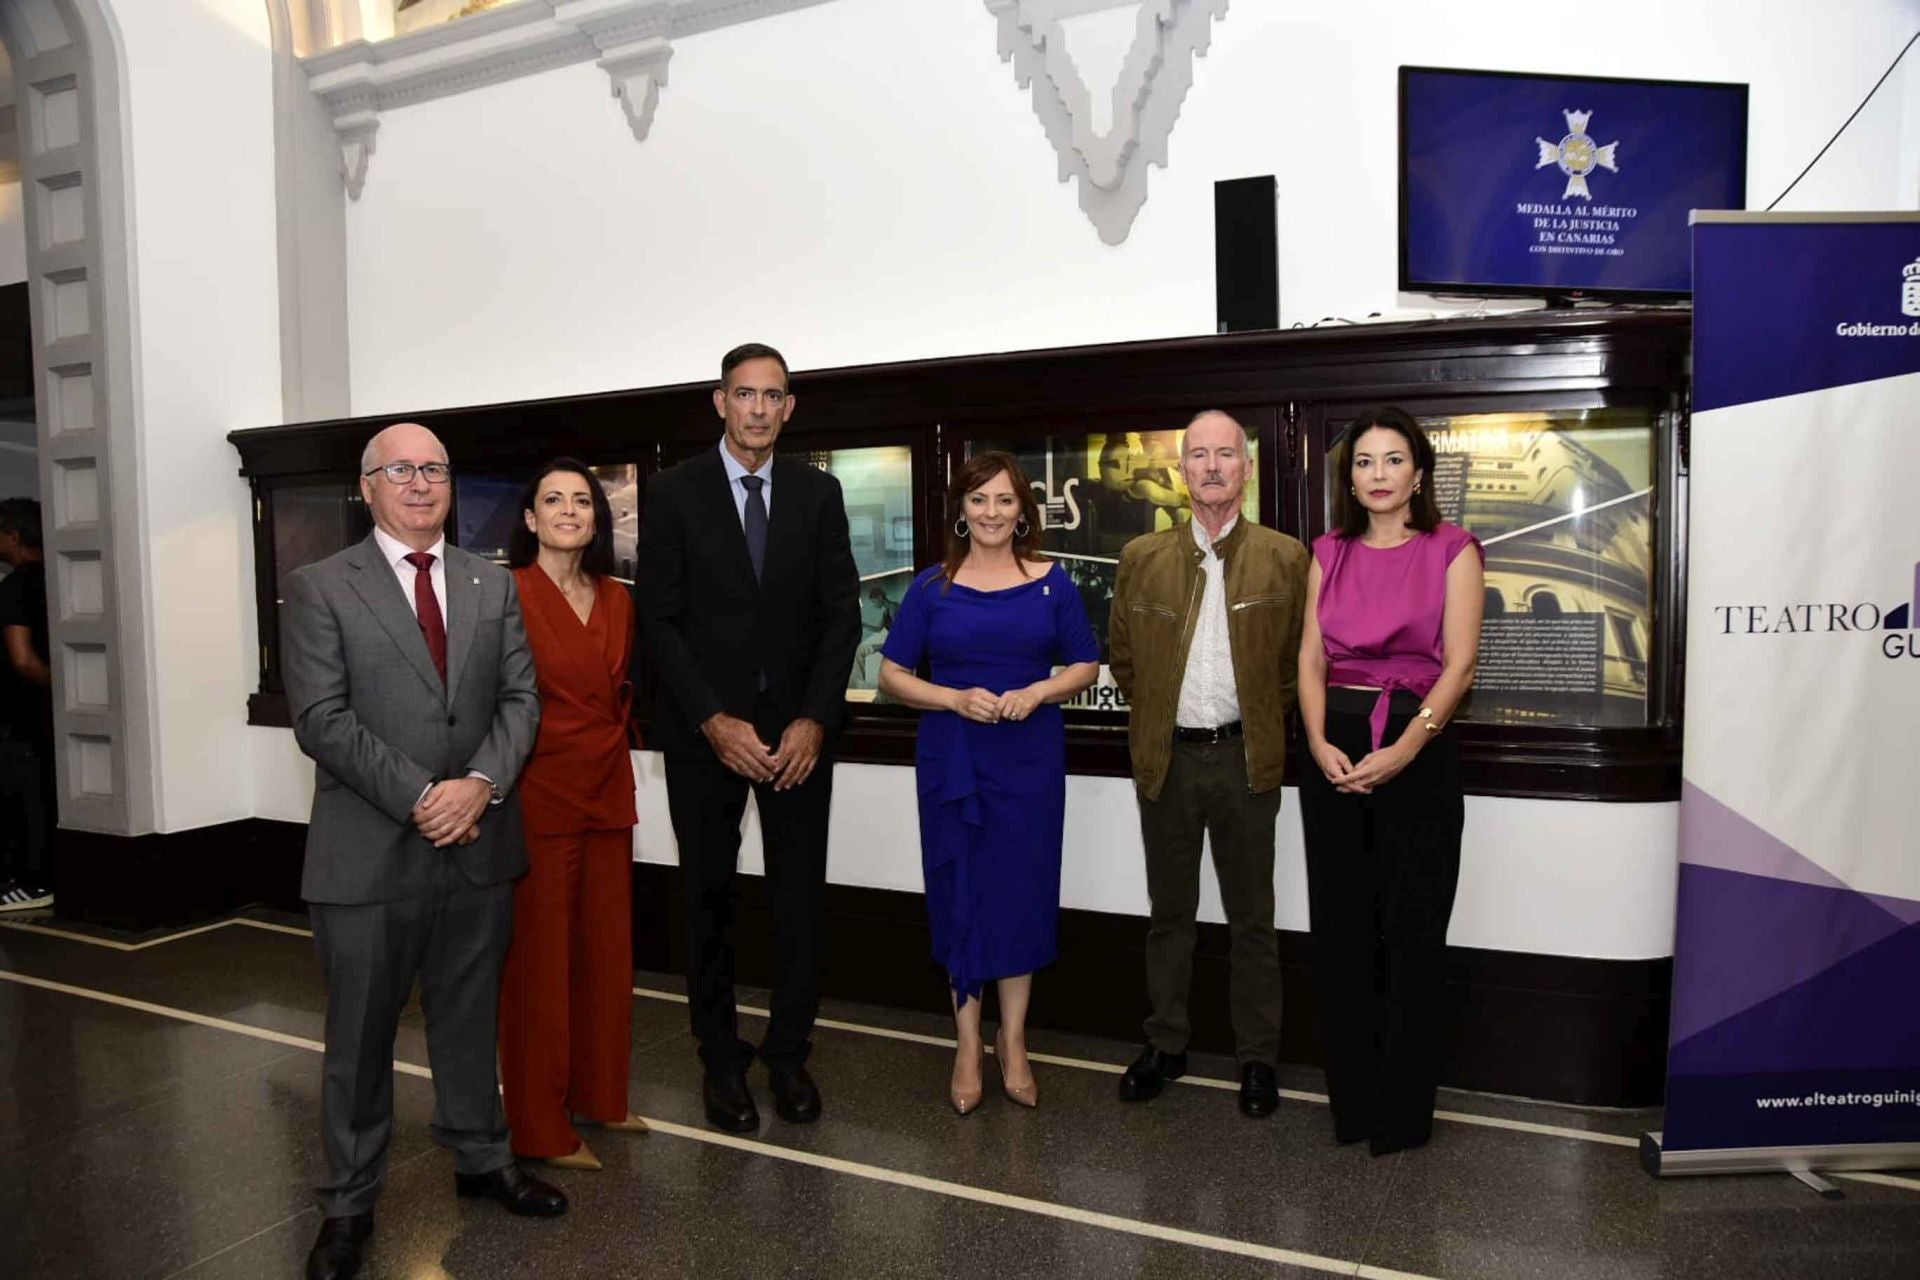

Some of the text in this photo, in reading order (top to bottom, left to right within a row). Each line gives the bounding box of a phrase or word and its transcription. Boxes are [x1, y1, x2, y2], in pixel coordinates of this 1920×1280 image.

[1516, 203, 1637, 218] MEDALLA AL MÉRITO
[1533, 218, 1620, 231] DE LA JUSTICIA
[1539, 231, 1615, 244] EN CANARIAS
[1836, 322, 1920, 336] Gobierno d
[1714, 602, 1881, 635] TEATRO
